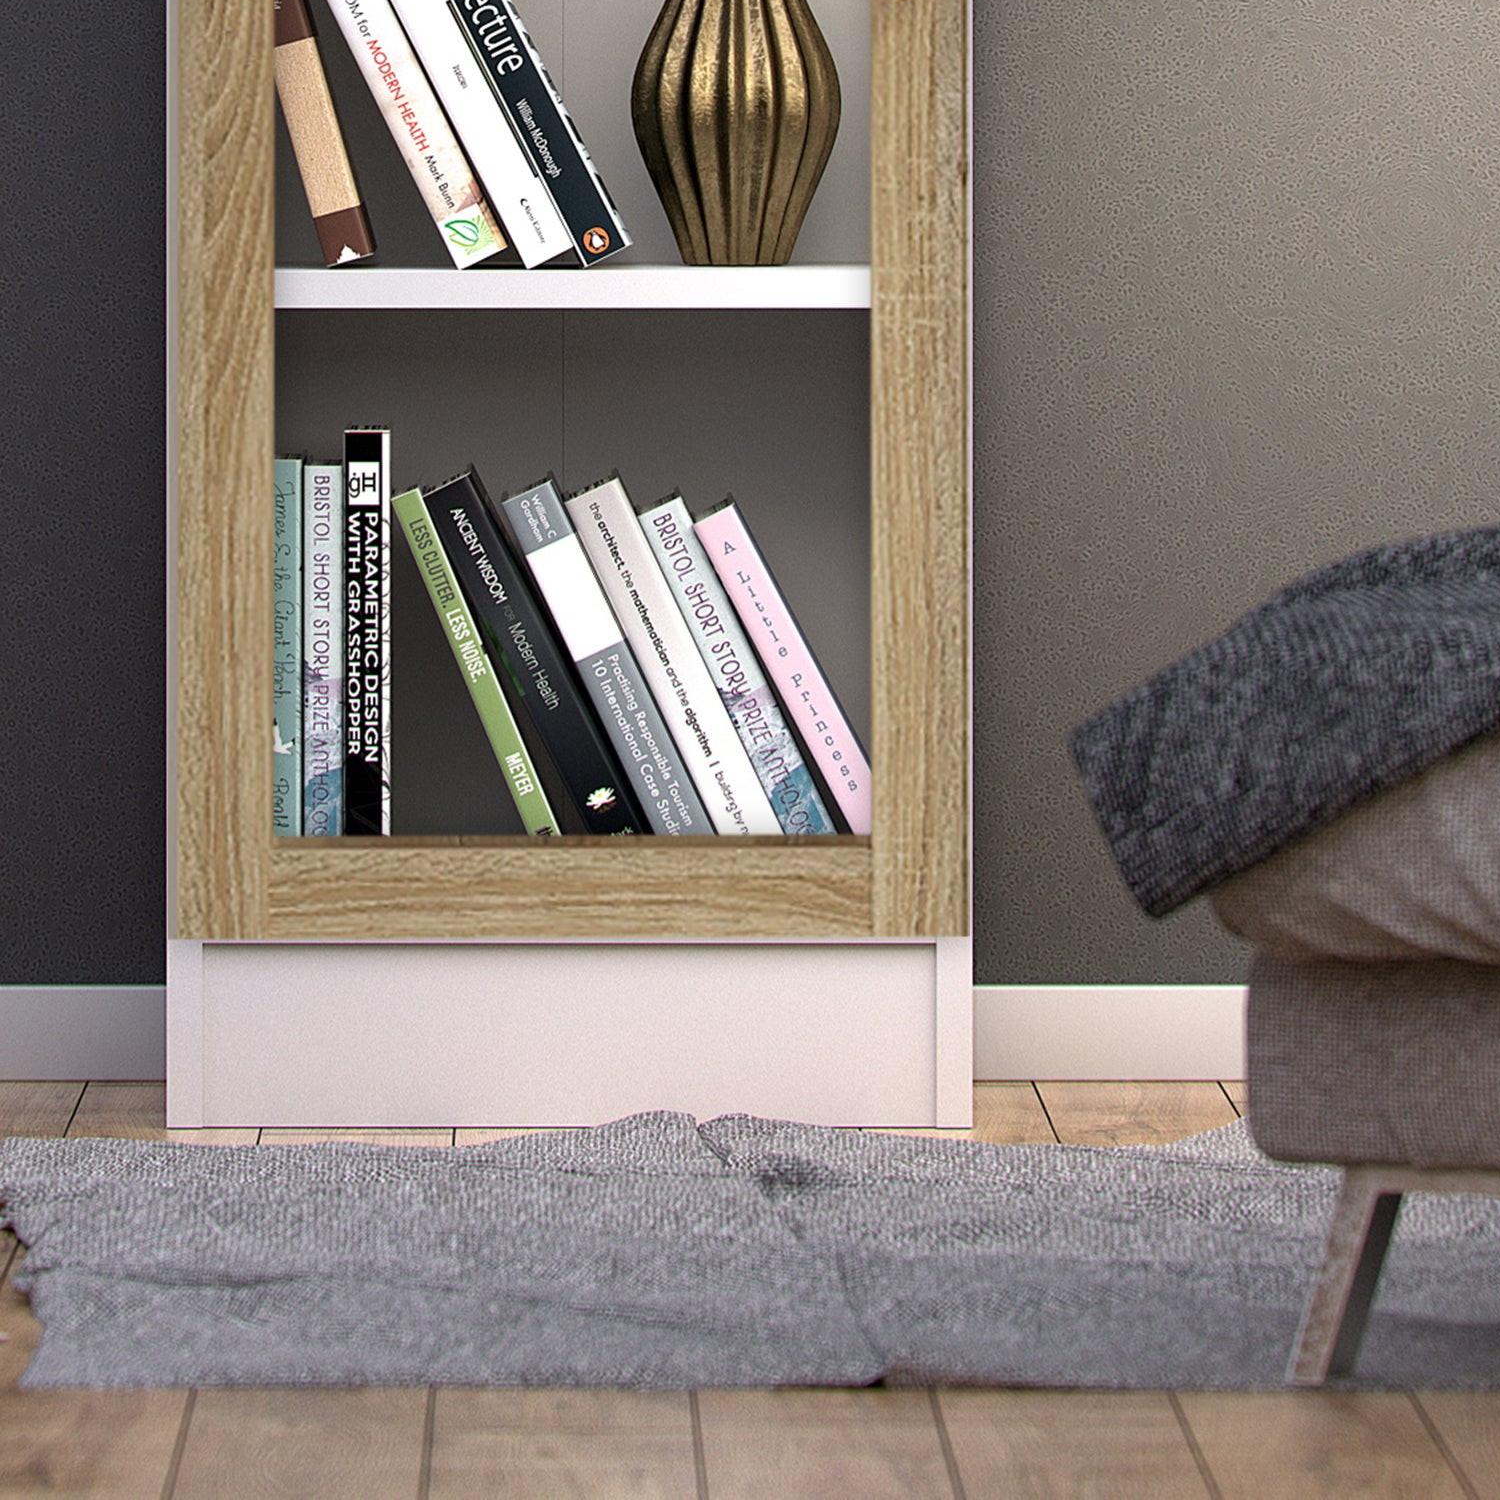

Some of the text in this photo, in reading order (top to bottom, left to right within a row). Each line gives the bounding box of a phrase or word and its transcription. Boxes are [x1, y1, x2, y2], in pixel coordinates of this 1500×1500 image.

[356, 19, 372, 38] for
[366, 39, 405, 102] MODERN
[397, 101, 430, 152] HEALTH
[424, 154, 445, 183] Mark
[438, 182, 456, 210] Bunn
[515, 97, 536, 131] William
[529, 128, 563, 179] McDonough
[273, 480, 296, 539] James
[313, 475, 330, 546] BRISTOL
[313, 553, 330, 613] SHORT
[532, 494, 557, 539] William C
[312, 619, 330, 678] STORY
[348, 511, 361, 755] WITH GRASSHOPPER
[364, 512, 379, 763] PARAMETRIC DESIGN
[409, 518, 487, 684] LESS CLUTTER. LESS NOISE.
[450, 508, 560, 711] ANCIENT WISDOM FOR Modern Health
[589, 502, 713, 758] the architect, the mathematician and the algorithm
[652, 512, 697, 583] BRISTOL
[684, 582, 725, 638] SHORT
[711, 640, 751, 697] STORY
[738, 697, 773, 746] PRIZE
[723, 541, 858, 792] A Little Princess
[312, 685, 330, 731] PRIZE
[505, 751, 534, 797] MEYER
[591, 659, 608, 678] 10
[600, 678, 646, 763] International
[640, 763, 660, 798] Case
[607, 653, 692, 828] Practising Responsible Tourism
